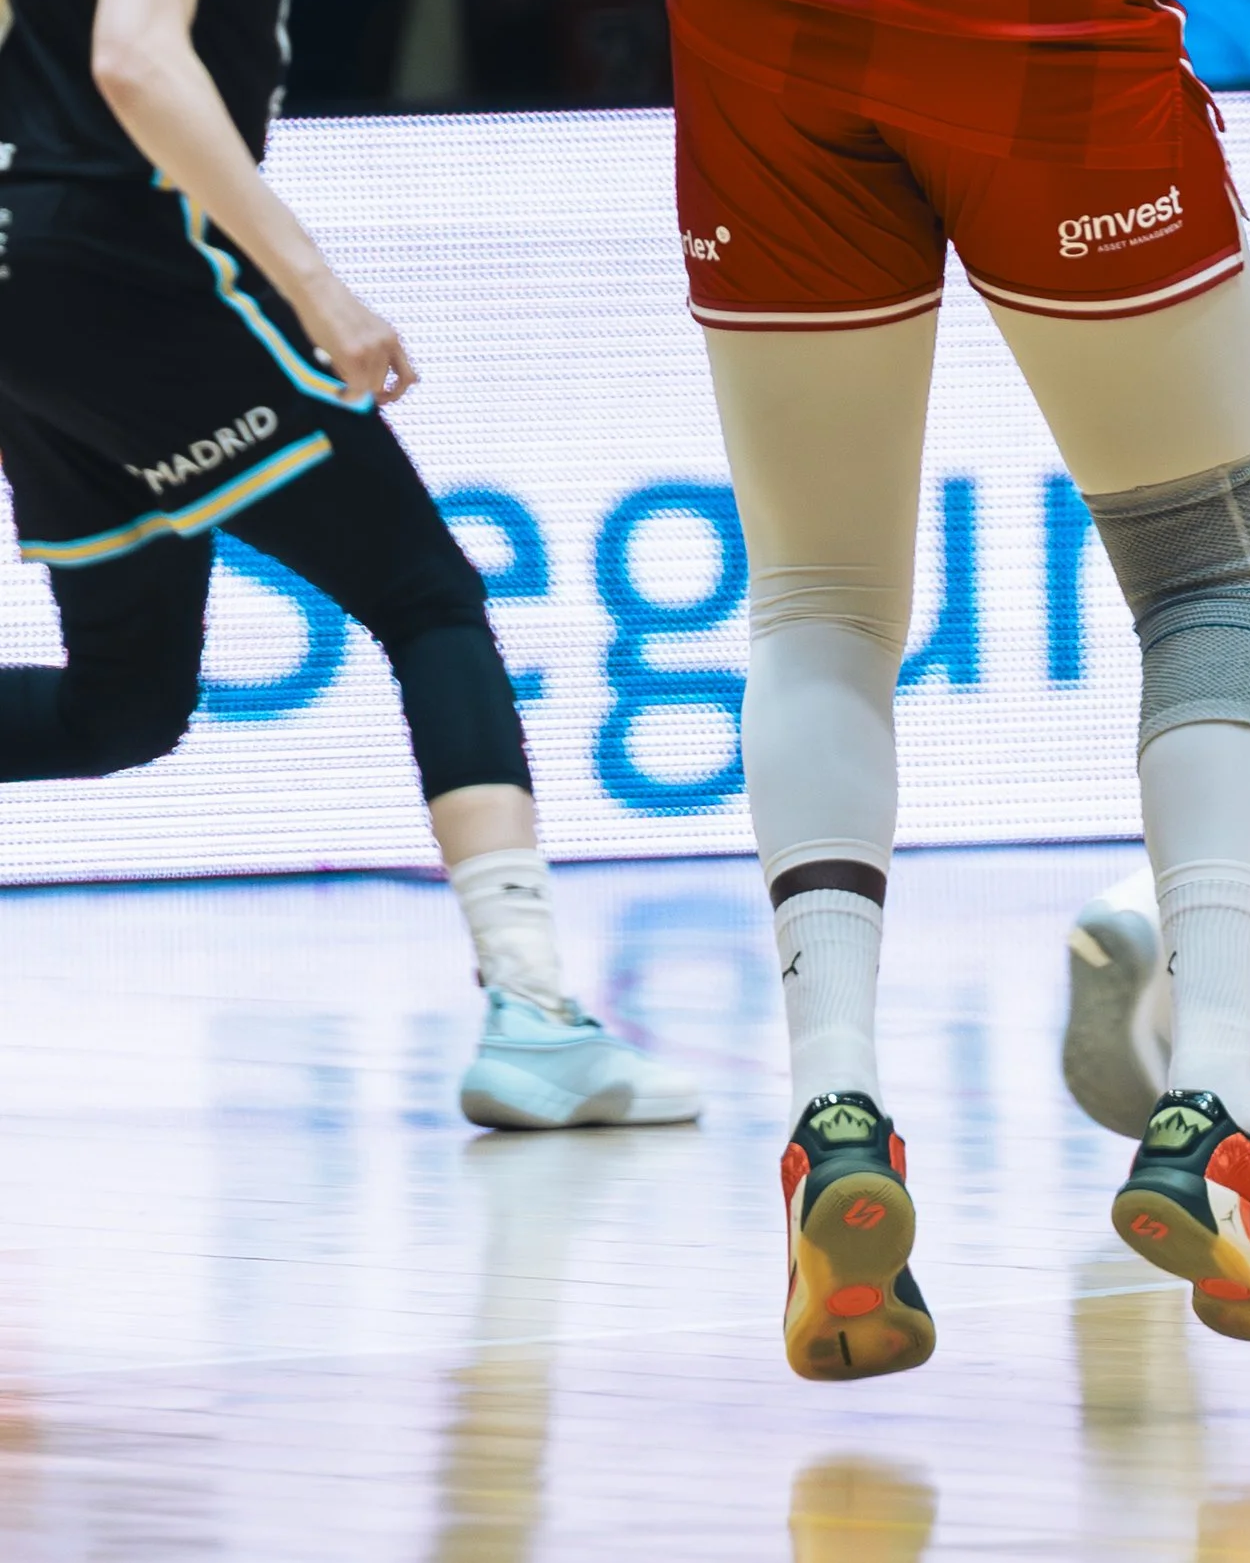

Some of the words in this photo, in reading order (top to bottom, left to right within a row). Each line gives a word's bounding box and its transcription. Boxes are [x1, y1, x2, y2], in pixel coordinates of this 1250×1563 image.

[1057, 184, 1184, 258] ginvest
[1097, 239, 1128, 253] ASSET
[1128, 219, 1183, 246] MANAGEMENT
[141, 405, 279, 496] MADRID
